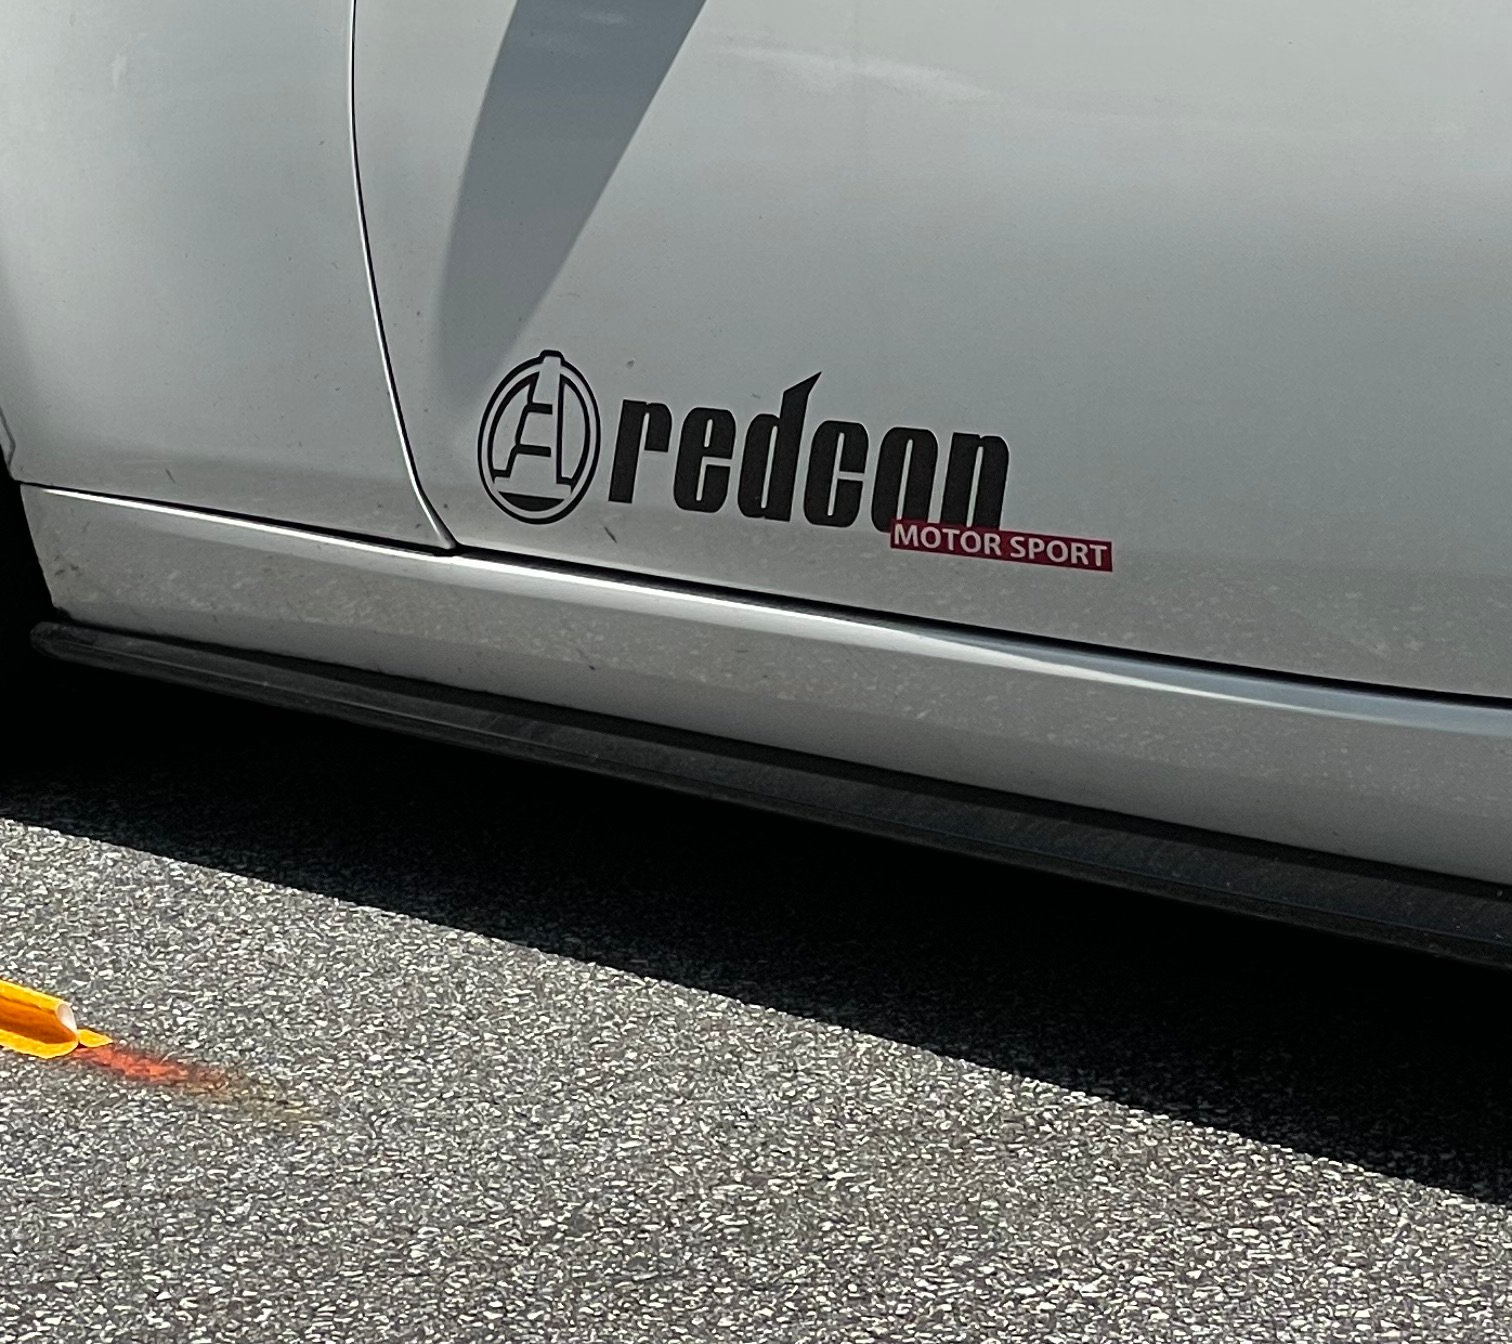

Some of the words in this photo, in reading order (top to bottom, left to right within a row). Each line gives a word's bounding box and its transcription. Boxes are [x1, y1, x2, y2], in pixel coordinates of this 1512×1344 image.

[608, 371, 1009, 533] redcon
[893, 523, 1003, 557] MOTOR
[1008, 537, 1109, 568] SPORT
